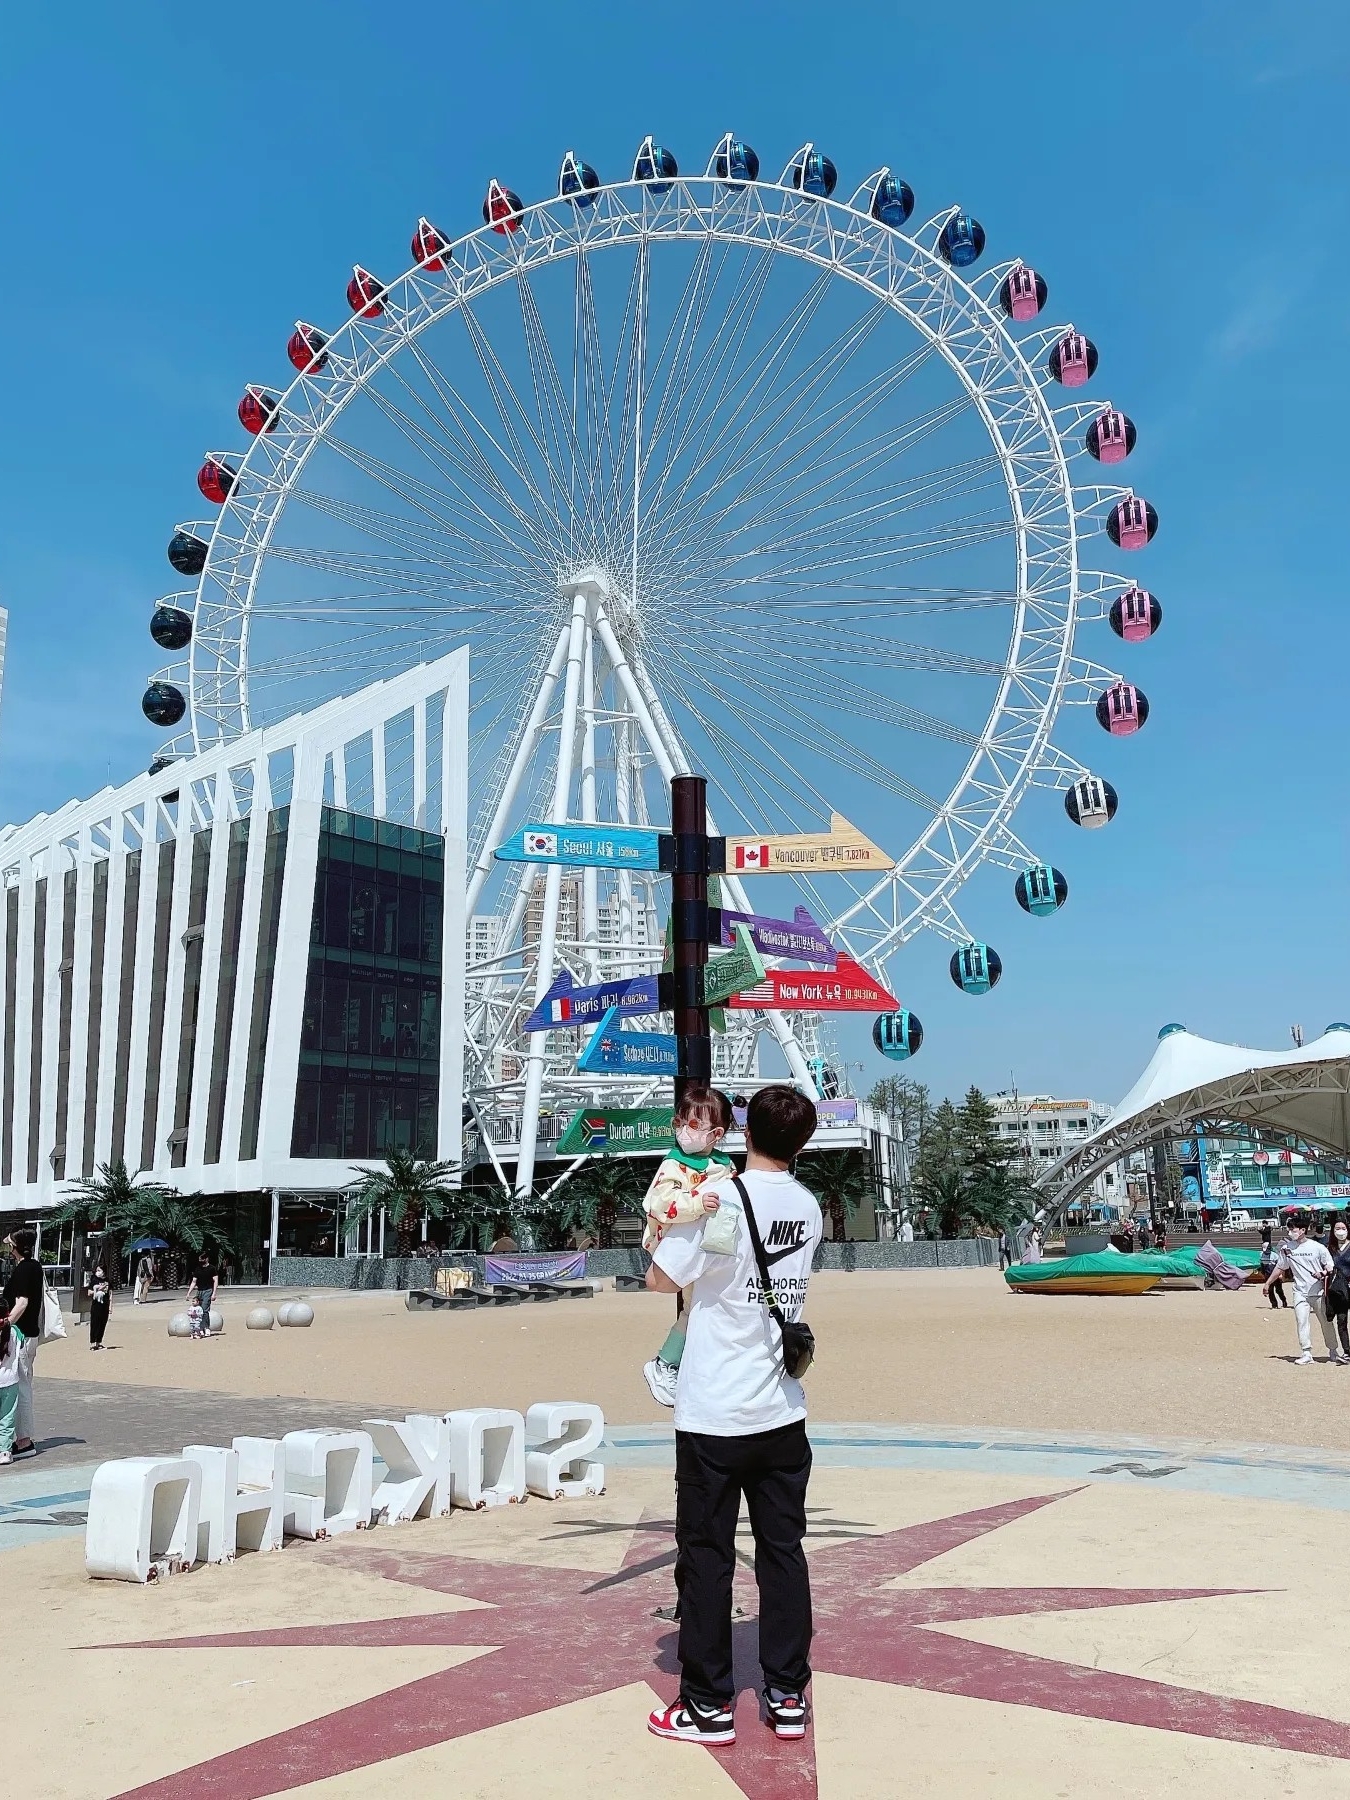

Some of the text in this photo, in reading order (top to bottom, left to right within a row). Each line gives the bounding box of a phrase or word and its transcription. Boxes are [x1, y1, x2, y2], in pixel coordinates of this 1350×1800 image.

[563, 838, 593, 856] Seoul
[597, 841, 614, 857] 서울
[775, 848, 819, 863] Vancouver
[780, 983, 798, 999] New
[801, 983, 823, 1000] York
[826, 984, 842, 1001] 뉴욕
[574, 996, 599, 1014] Paris
[601, 992, 618, 1009] 파리
[609, 1122, 635, 1140] Durban
[638, 1121, 651, 1139] 더반
[767, 1220, 806, 1246] NIKE
